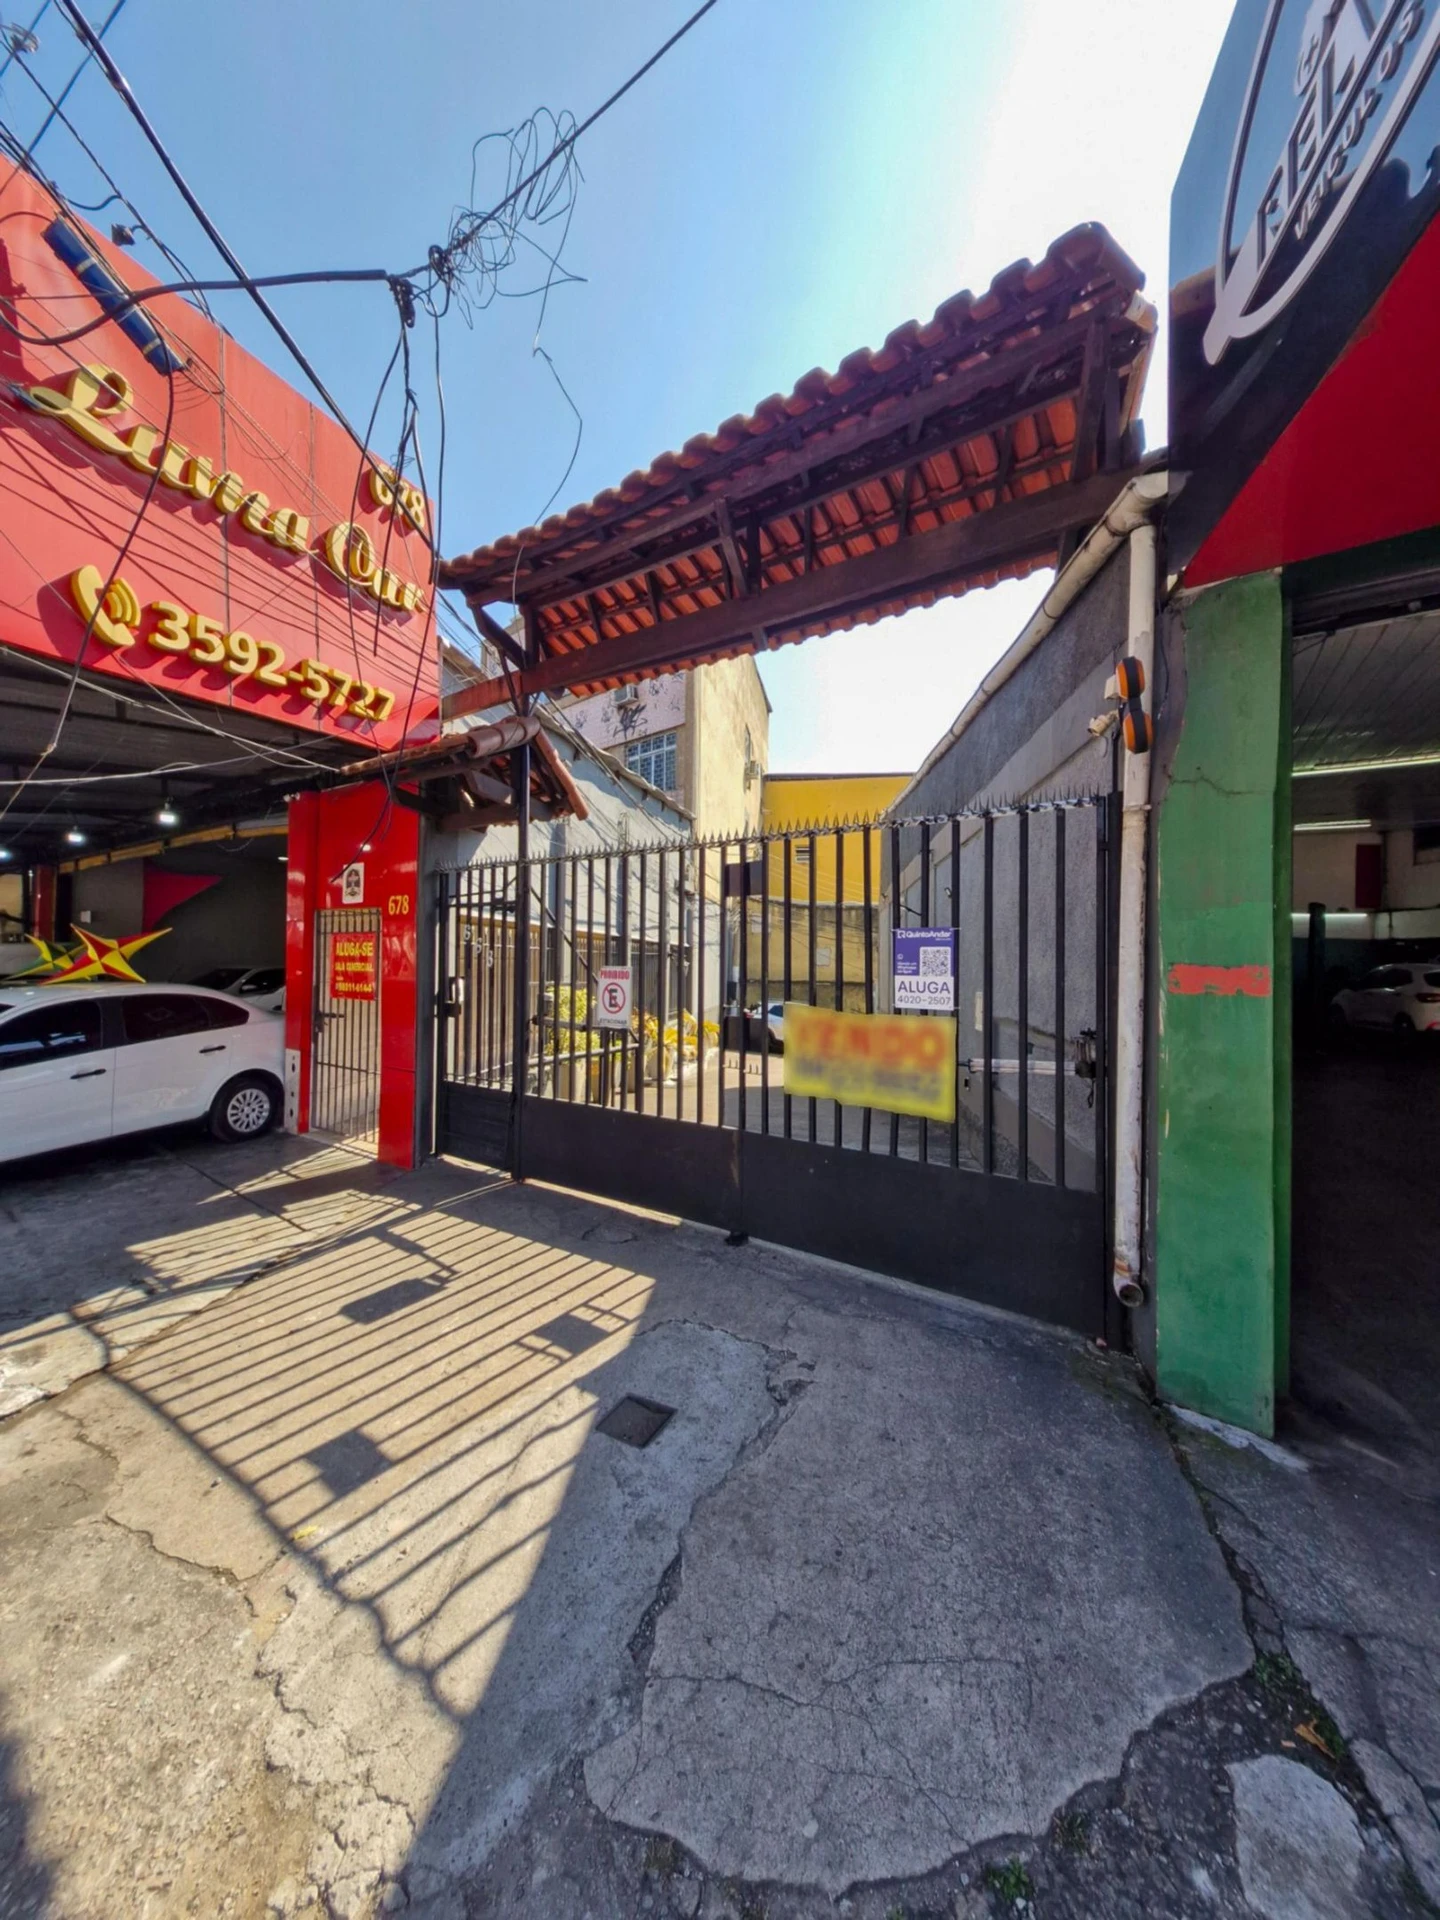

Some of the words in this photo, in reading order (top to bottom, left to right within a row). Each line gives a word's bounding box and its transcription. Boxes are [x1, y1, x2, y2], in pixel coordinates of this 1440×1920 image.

[147, 601, 396, 722] 3592-5727
[388, 894, 410, 916] 678
[906, 930, 952, 939] QuintoAndar
[600, 970, 630, 980] PROIBIDO
[898, 980, 951, 995] ALUGA
[897, 995, 952, 1006] 4020-2507
